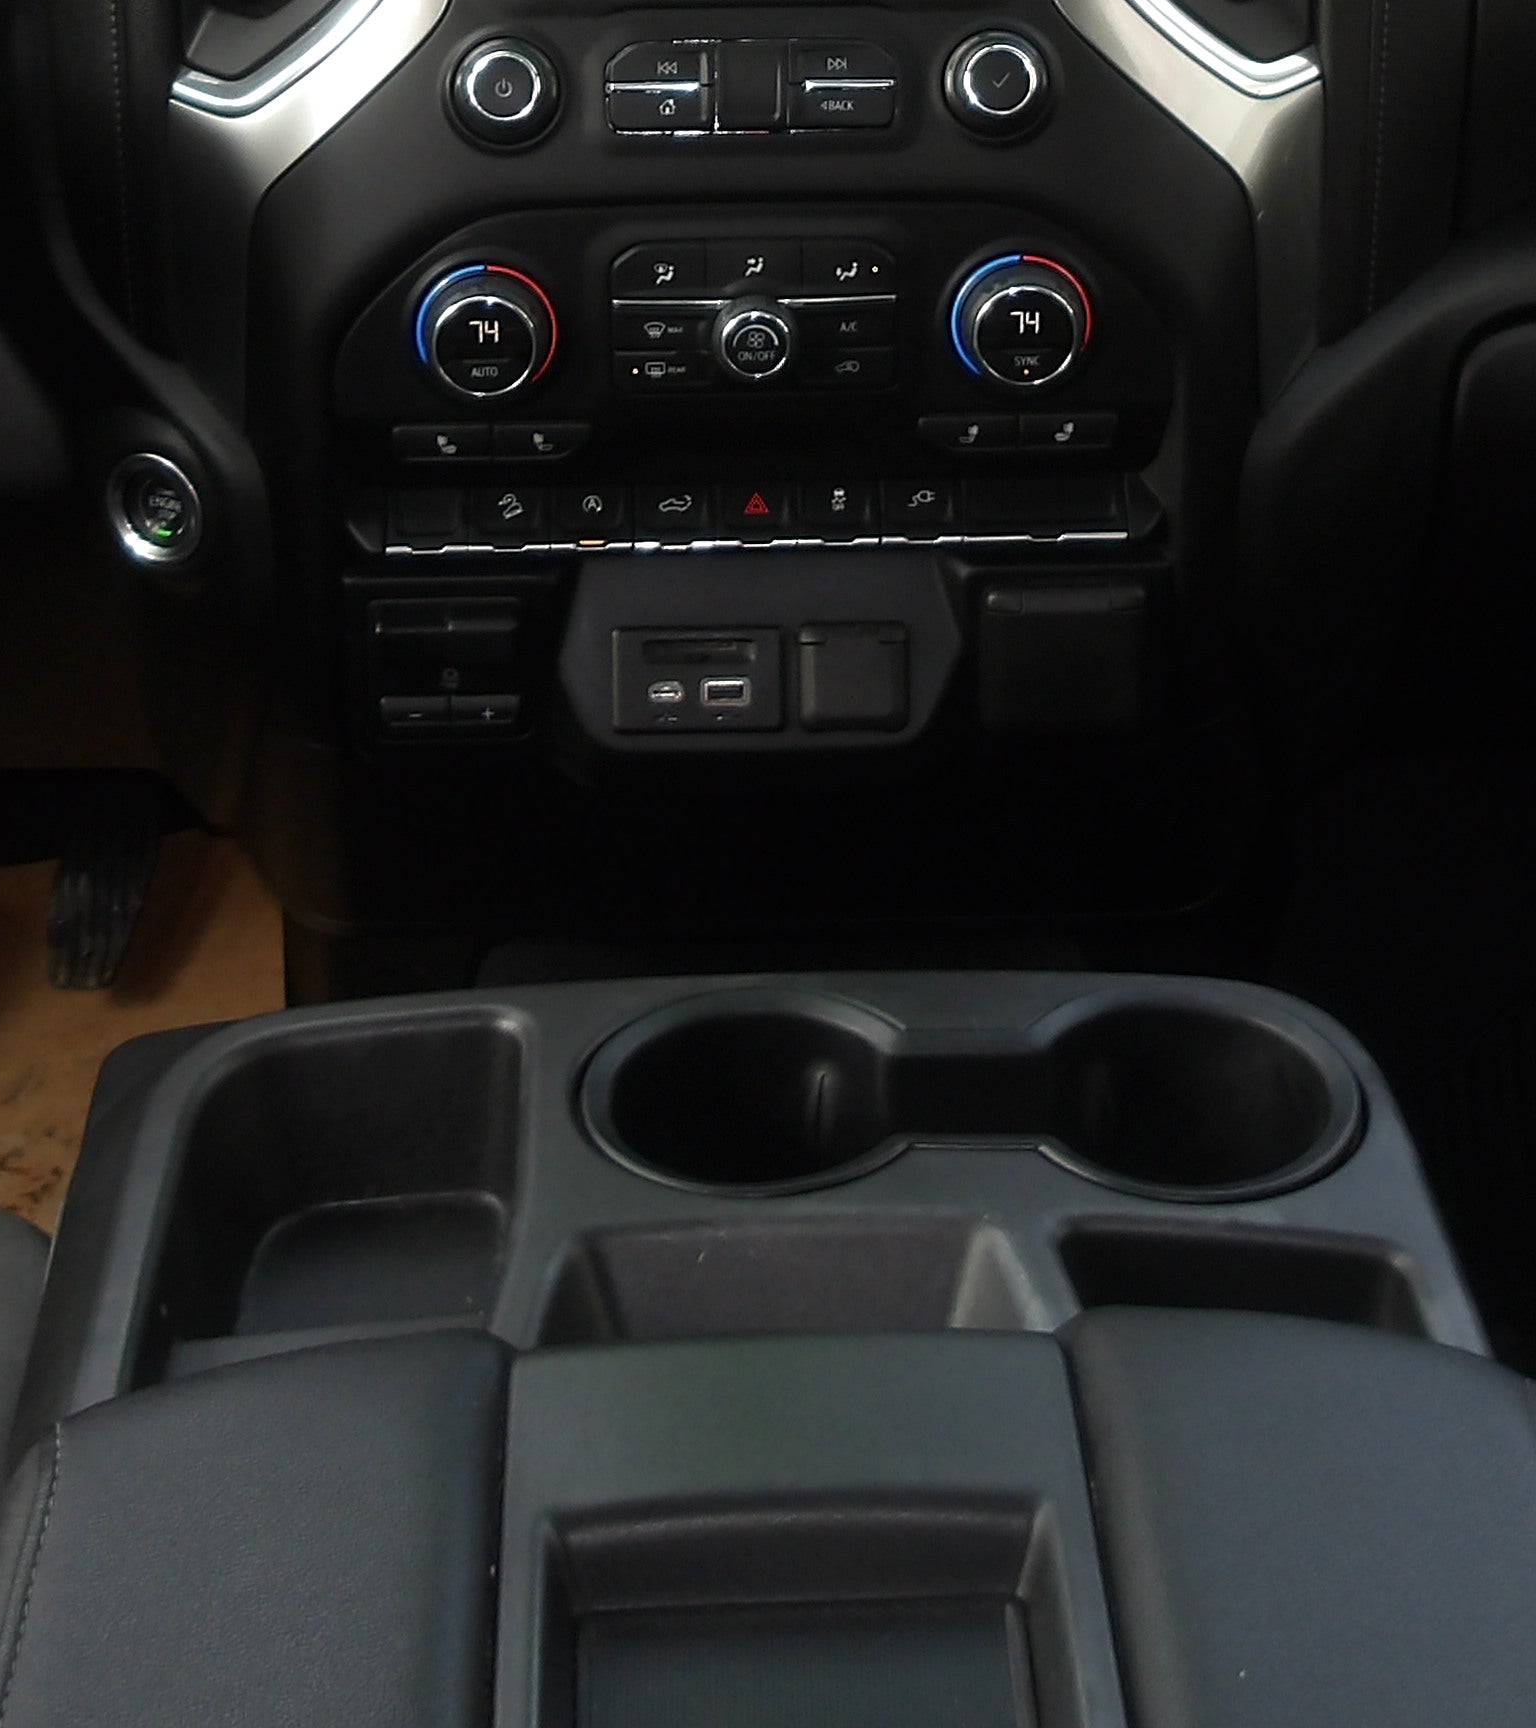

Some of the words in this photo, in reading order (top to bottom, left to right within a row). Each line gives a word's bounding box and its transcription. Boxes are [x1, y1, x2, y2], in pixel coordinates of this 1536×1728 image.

[827, 99, 855, 112] BACK
[1010, 311, 1040, 334] 74
[468, 320, 500, 344] 74
[738, 350, 775, 362] ON/OFF
[1014, 356, 1039, 367] SYNC
[471, 366, 499, 379] AUTO
